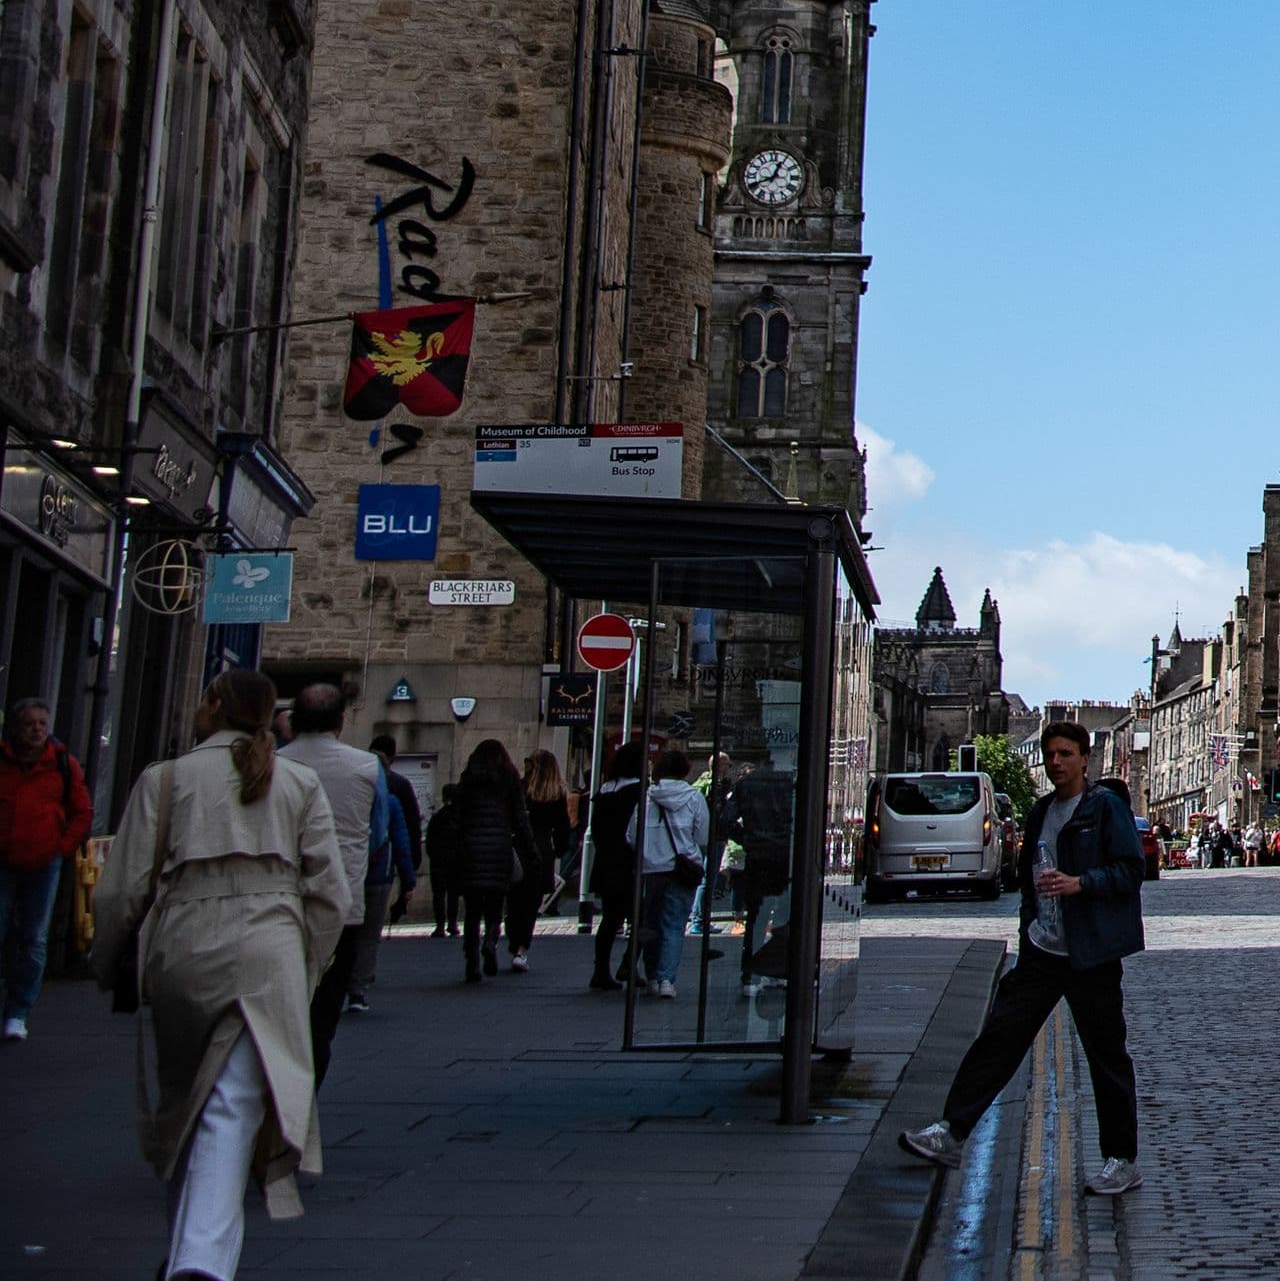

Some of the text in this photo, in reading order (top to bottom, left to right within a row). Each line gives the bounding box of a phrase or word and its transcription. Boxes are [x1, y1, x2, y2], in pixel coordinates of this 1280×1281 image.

[480, 425, 587, 436] Museum of Childhood
[519, 440, 531, 448] 35
[612, 466, 655, 477] Bus Stop
[362, 514, 432, 534] BLU
[433, 582, 512, 593] BLACKFRIARS
[450, 593, 493, 603] STREET
